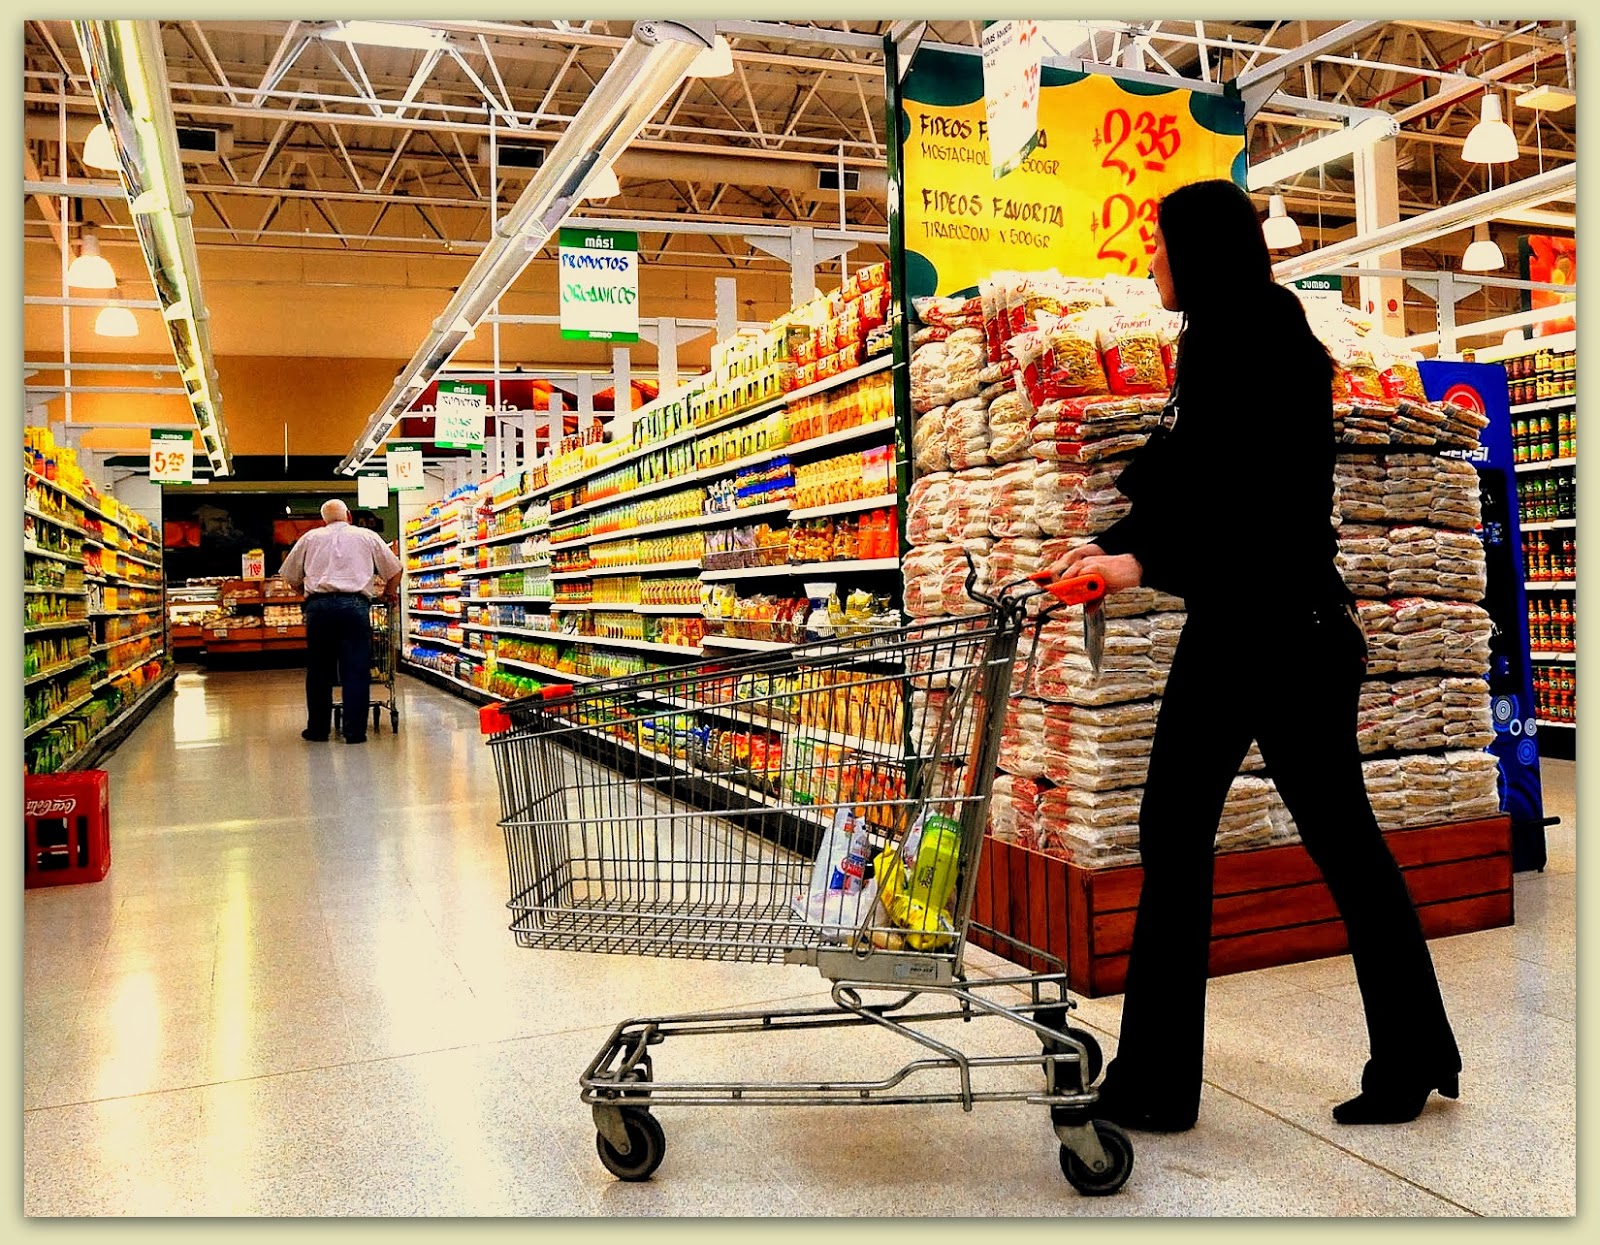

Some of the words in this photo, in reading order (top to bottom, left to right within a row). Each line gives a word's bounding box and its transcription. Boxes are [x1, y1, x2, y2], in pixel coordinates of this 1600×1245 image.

[919, 113, 972, 140] FIDEOS
[921, 188, 983, 216] FIDEOS
[921, 221, 990, 242] TIRABUZON
[561, 252, 630, 272] PRODUCTOS
[1301, 280, 1331, 290] JUMBO
